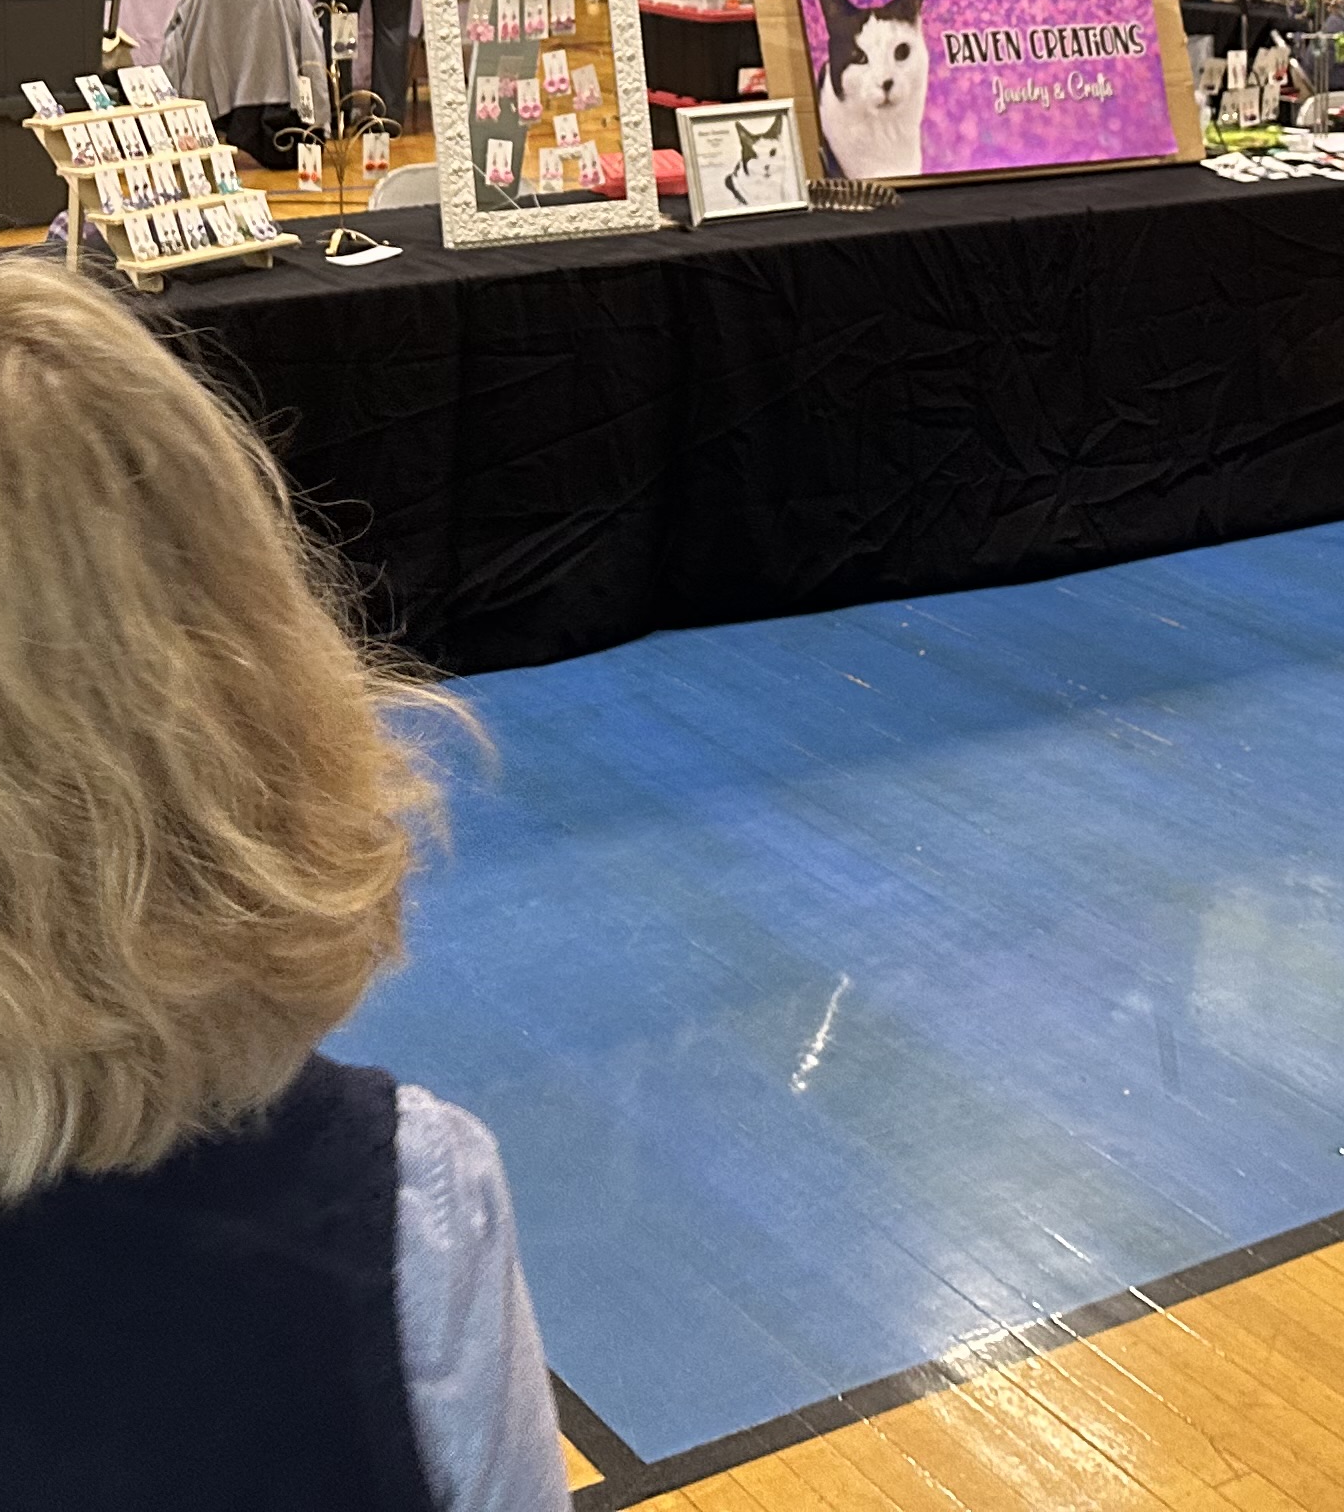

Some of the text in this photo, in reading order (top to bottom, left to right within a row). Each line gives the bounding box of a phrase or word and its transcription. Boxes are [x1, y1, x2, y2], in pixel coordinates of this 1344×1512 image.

[943, 30, 1022, 65] RAVEN
[992, 70, 1114, 114] Jewelry & Crafts
